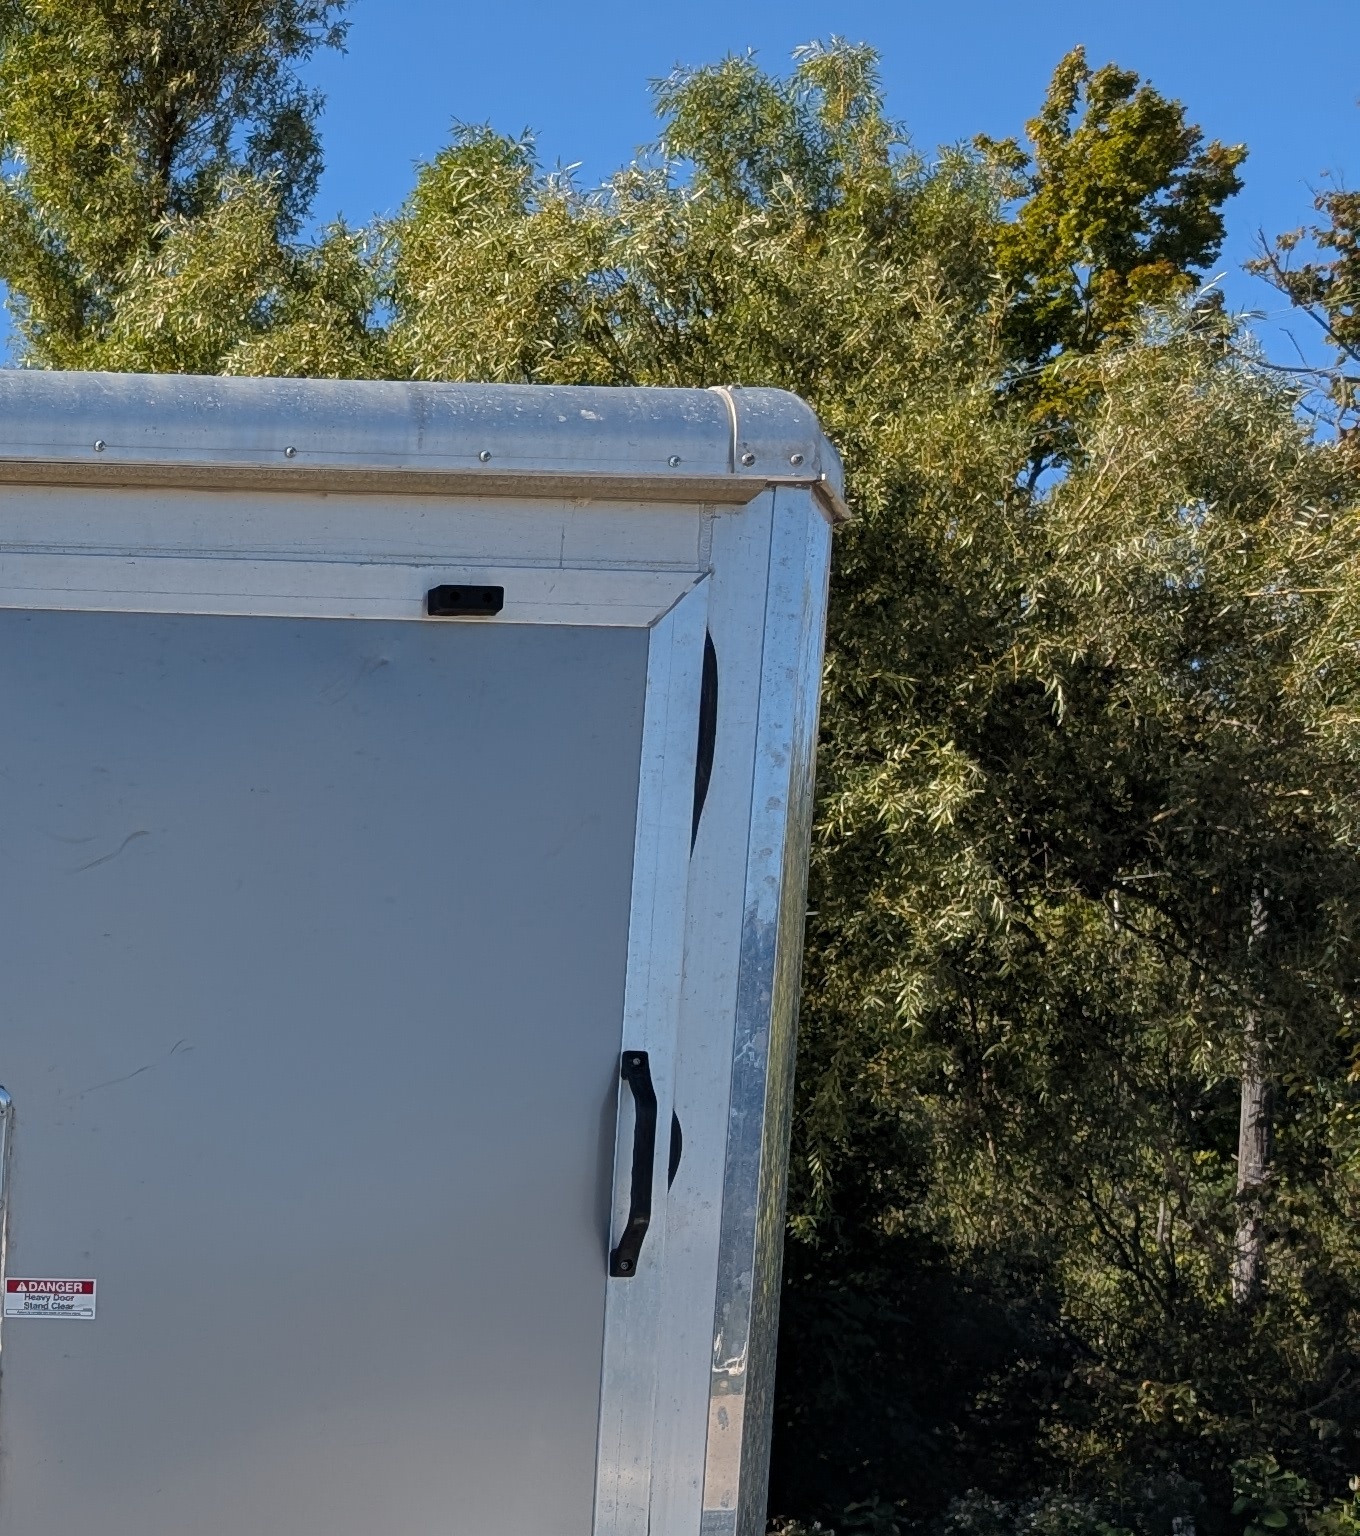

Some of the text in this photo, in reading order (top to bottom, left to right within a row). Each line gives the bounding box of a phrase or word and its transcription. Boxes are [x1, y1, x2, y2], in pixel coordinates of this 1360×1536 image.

[28, 1281, 83, 1293] DANGER
[24, 1293, 74, 1302] Heavy Door
[23, 1302, 48, 1310] Stand
[51, 1302, 74, 1310] Clear
